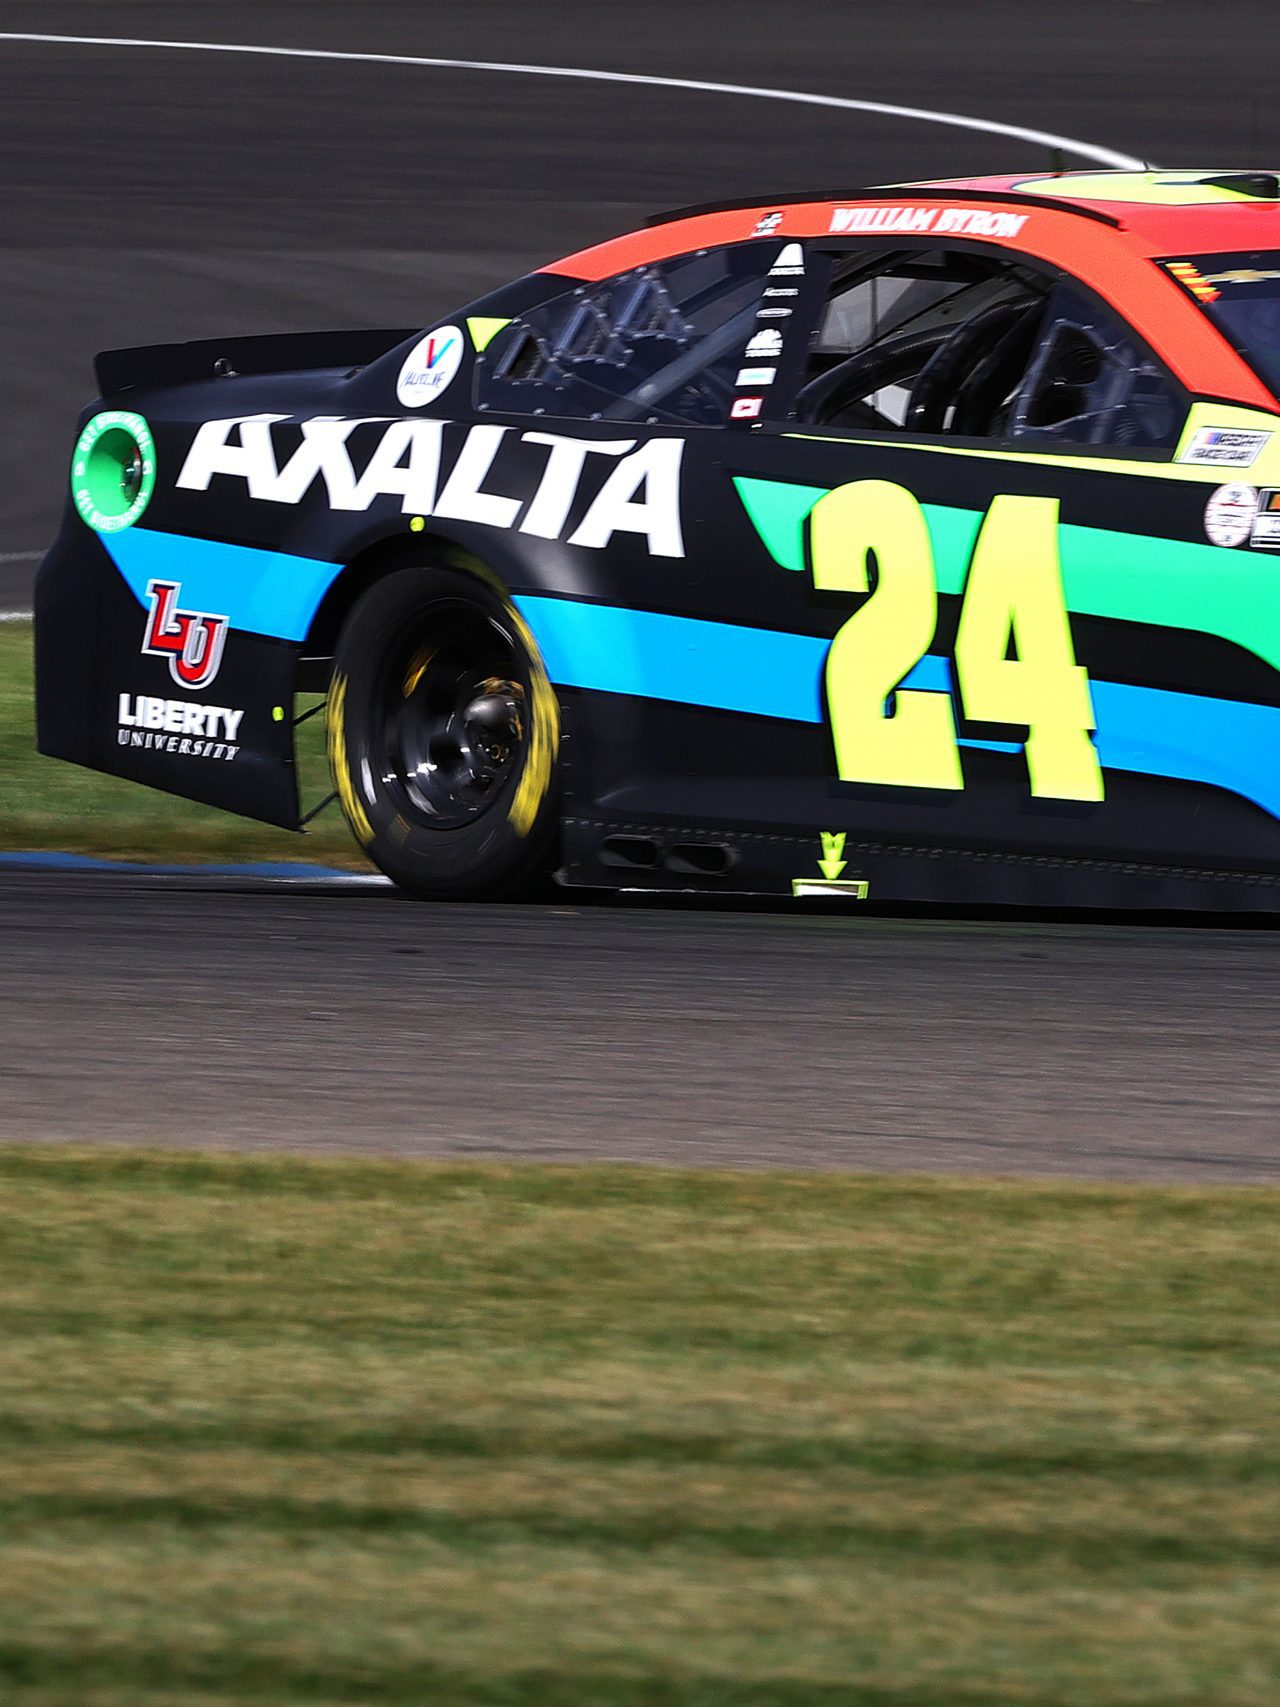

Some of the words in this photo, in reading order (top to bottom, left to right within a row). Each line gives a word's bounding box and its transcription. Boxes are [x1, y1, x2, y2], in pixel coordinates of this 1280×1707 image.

[828, 208, 939, 232] WILLIAM
[931, 208, 1030, 238] BYRON
[175, 413, 687, 558] AXALTA
[140, 578, 231, 690] LU
[810, 479, 1106, 802] 24
[117, 728, 240, 761] UNIVERSITY
[118, 693, 244, 741] LIBERTY
